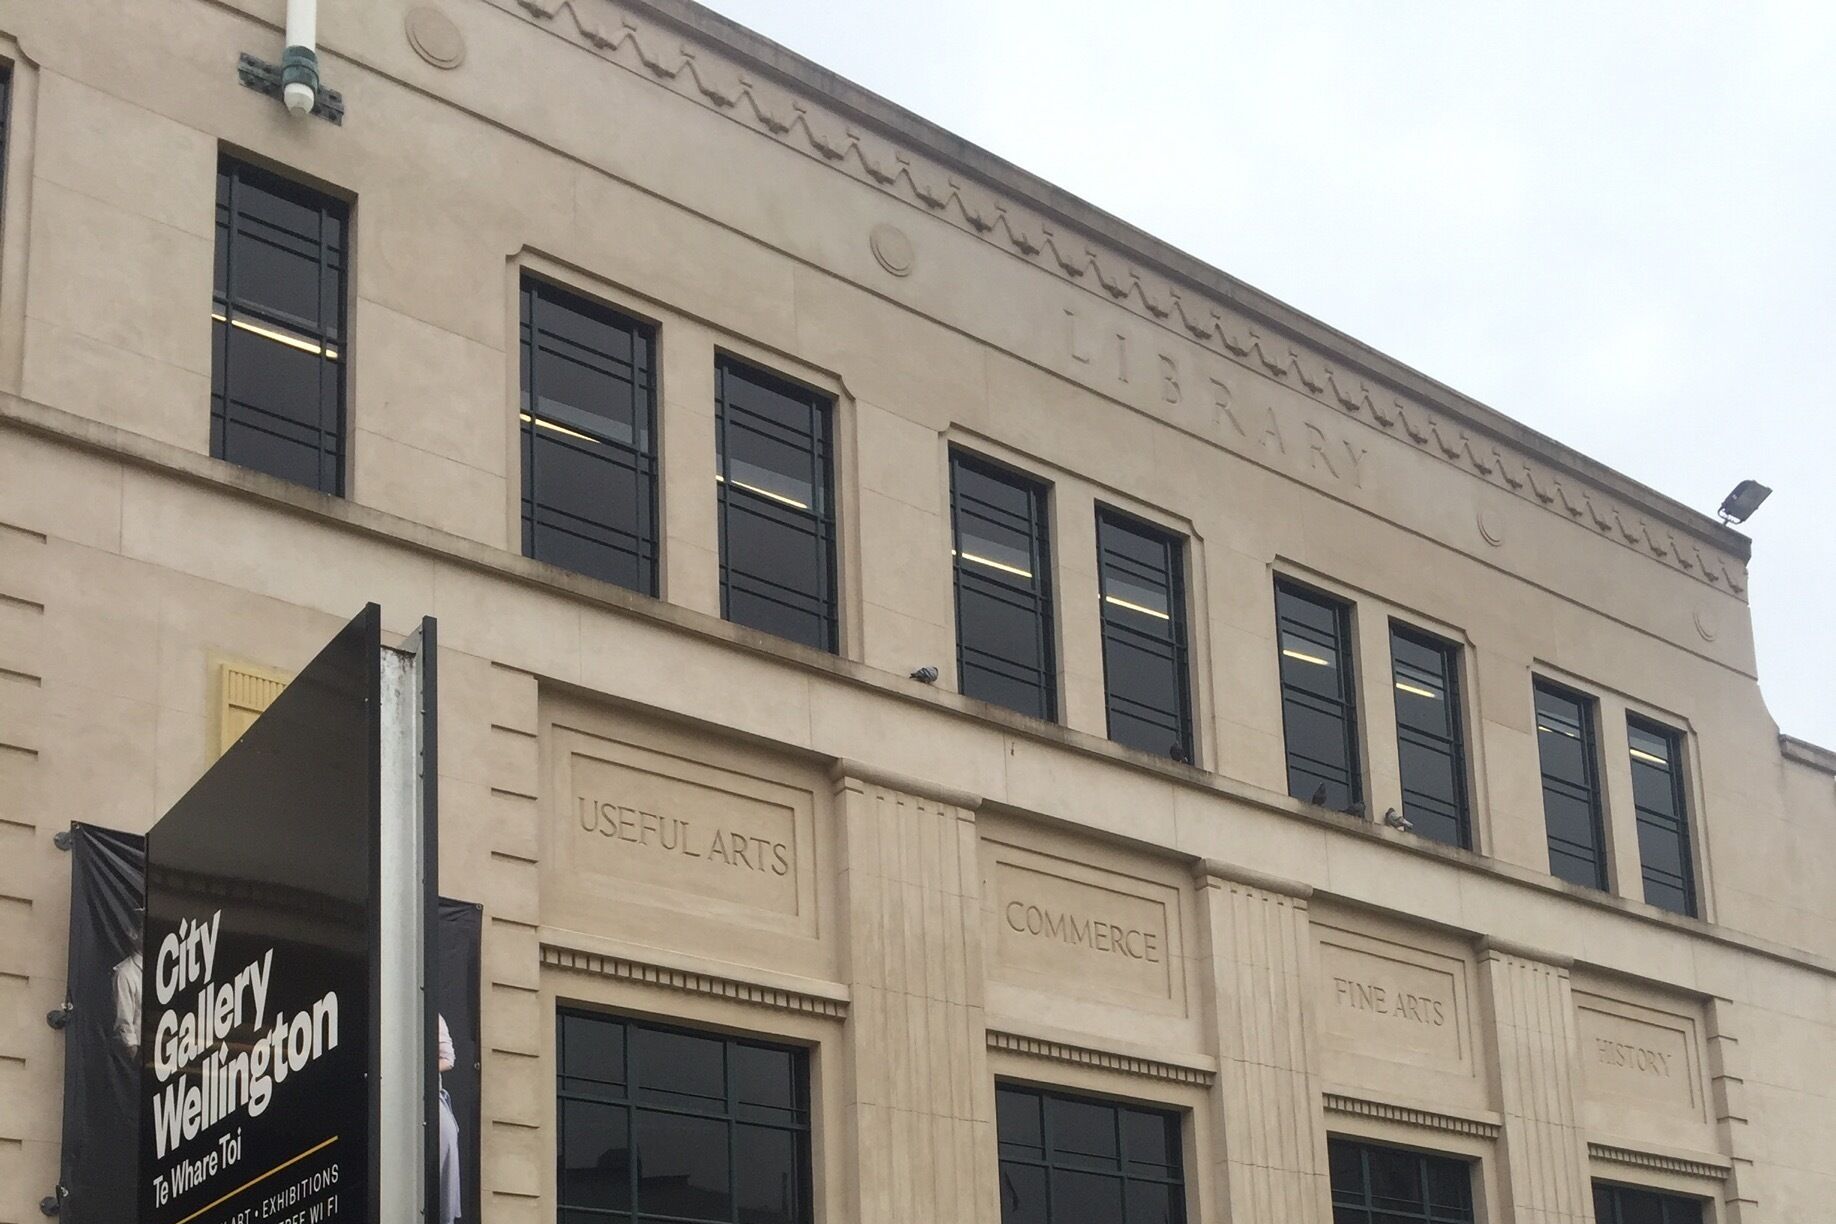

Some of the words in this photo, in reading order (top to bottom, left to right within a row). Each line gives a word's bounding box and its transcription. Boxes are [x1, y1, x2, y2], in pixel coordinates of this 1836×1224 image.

[1062, 307, 1368, 490] LIBRARY
[577, 796, 701, 858] USEFUL
[707, 828, 789, 876] ARTS
[155, 908, 222, 1005] City
[1005, 900, 1160, 963] COMMERCE
[154, 947, 274, 1083] Gallery
[1333, 976, 1388, 1014] FINE
[1393, 992, 1445, 1026] ARTS
[152, 990, 339, 1161] Wellington
[1595, 1037, 1672, 1079] HISTORY
[153, 1174, 170, 1209] Te
[171, 1150, 219, 1199] Whare
[218, 1126, 242, 1170] Toi
[262, 1163, 340, 1219] EXHIBITIONS
[309, 1202, 324, 1224] WI
[327, 1194, 339, 1217] FI
